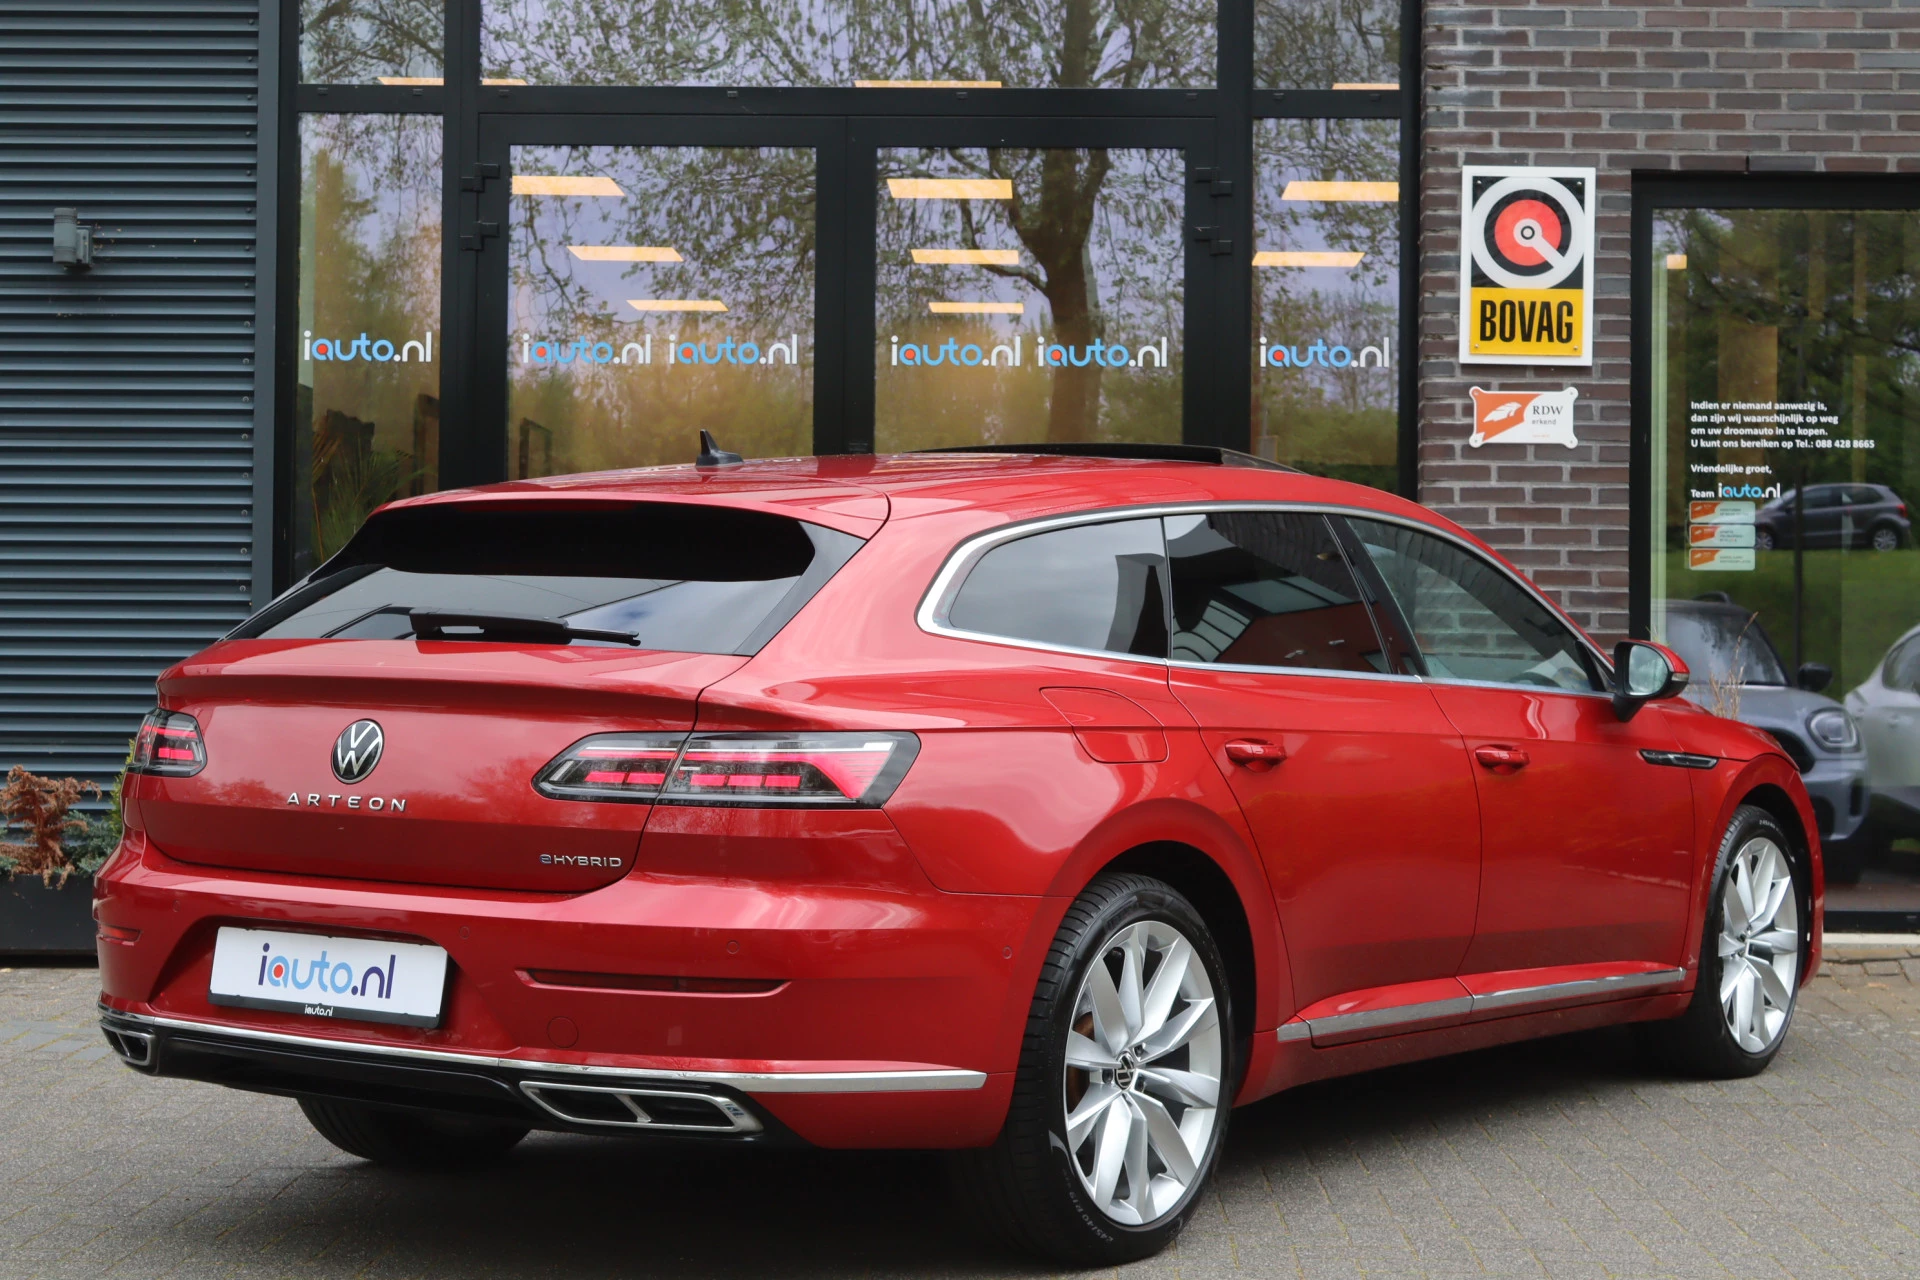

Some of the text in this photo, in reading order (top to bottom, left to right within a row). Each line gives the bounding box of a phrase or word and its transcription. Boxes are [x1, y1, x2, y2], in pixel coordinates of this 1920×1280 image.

[1479, 299, 1574, 344] BOVAG
[303, 330, 432, 363] iauto.nl
[522, 333, 798, 365] iauto.nl iauto.nl
[890, 335, 1168, 368] iauto.nl iauto.nl
[1259, 336, 1390, 369] iauto.nl
[1532, 405, 1564, 416] RDW
[1690, 401, 1828, 412] Indien er niemand aanwezig is,
[1531, 418, 1557, 426] erkend
[1690, 413, 1839, 425] dan zijn wij waarschijnlijk op weg
[1690, 427, 1706, 435] om
[1723, 426, 1774, 435] droomauto
[1775, 426, 1785, 435] in
[1786, 427, 1796, 435] te
[1797, 426, 1828, 437] kopen.
[1690, 438, 1875, 449] U kunt ons bereiken op Tel.: 088 428 8665
[1690, 464, 1772, 475] Vriendelijke groet,
[1690, 482, 1781, 498] Team iauto.nl
[286, 792, 407, 812] ARTEON
[258, 942, 397, 999] iauto.nl
[304, 1004, 334, 1017] iauto.nl
